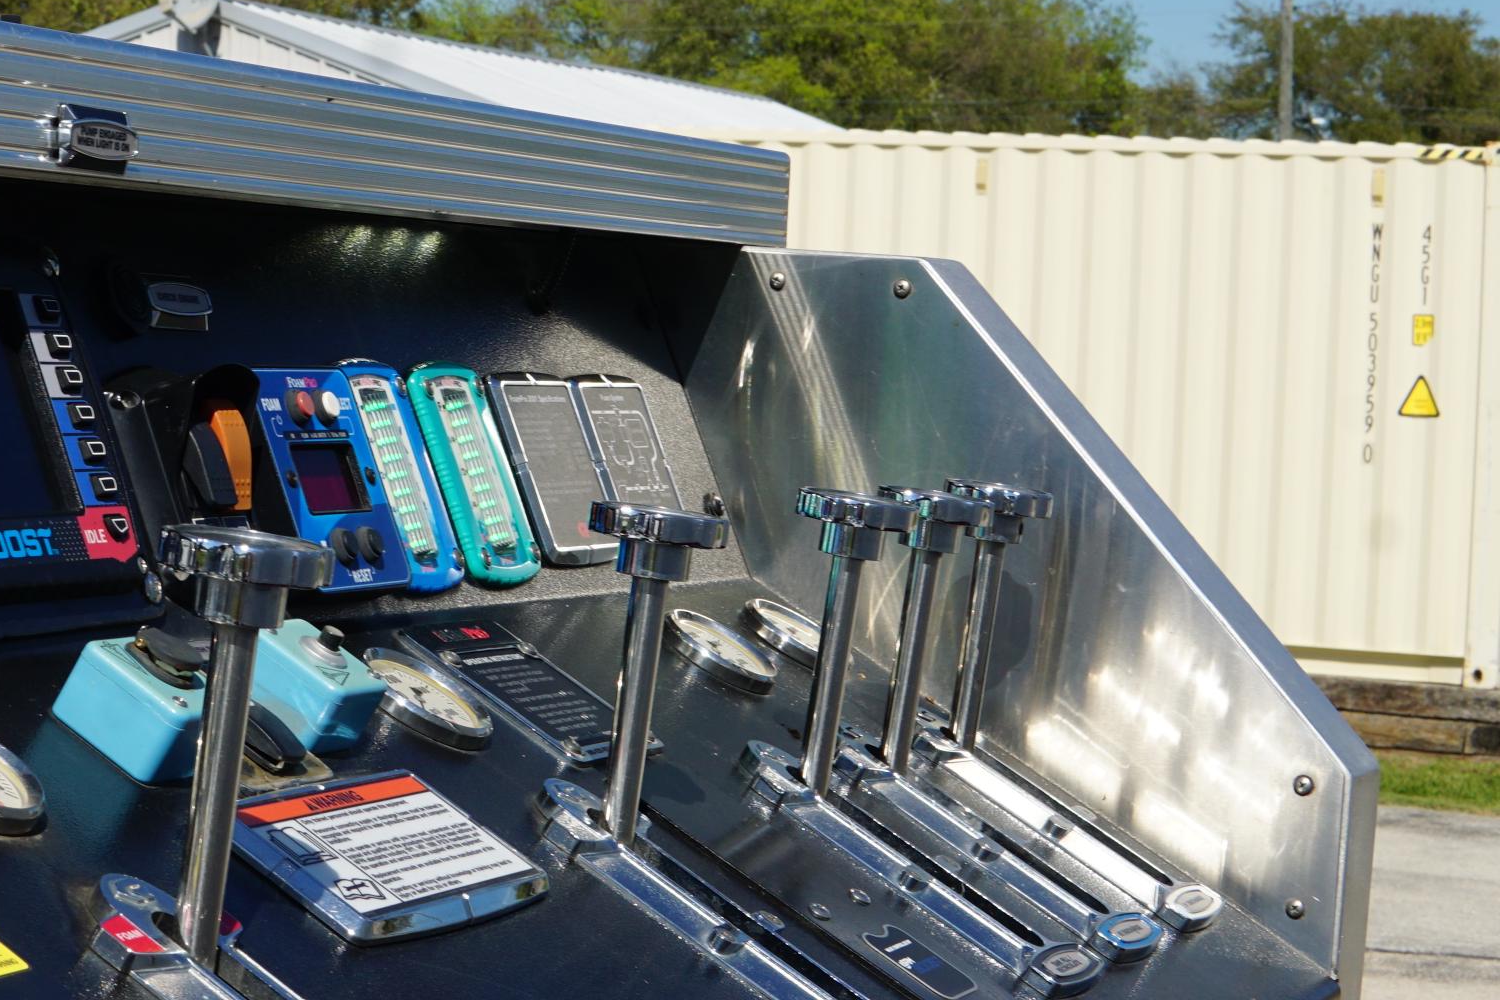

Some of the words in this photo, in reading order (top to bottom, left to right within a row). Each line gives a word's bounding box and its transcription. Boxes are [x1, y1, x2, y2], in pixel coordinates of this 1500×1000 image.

[1370, 223, 1384, 304] WNGU
[1364, 312, 1378, 434] 503959
[261, 398, 282, 411] FOAM
[84, 529, 108, 544] IDLE
[353, 568, 373, 582] RESET
[314, 790, 364, 808] WARNING
[115, 929, 145, 943] FOAM
